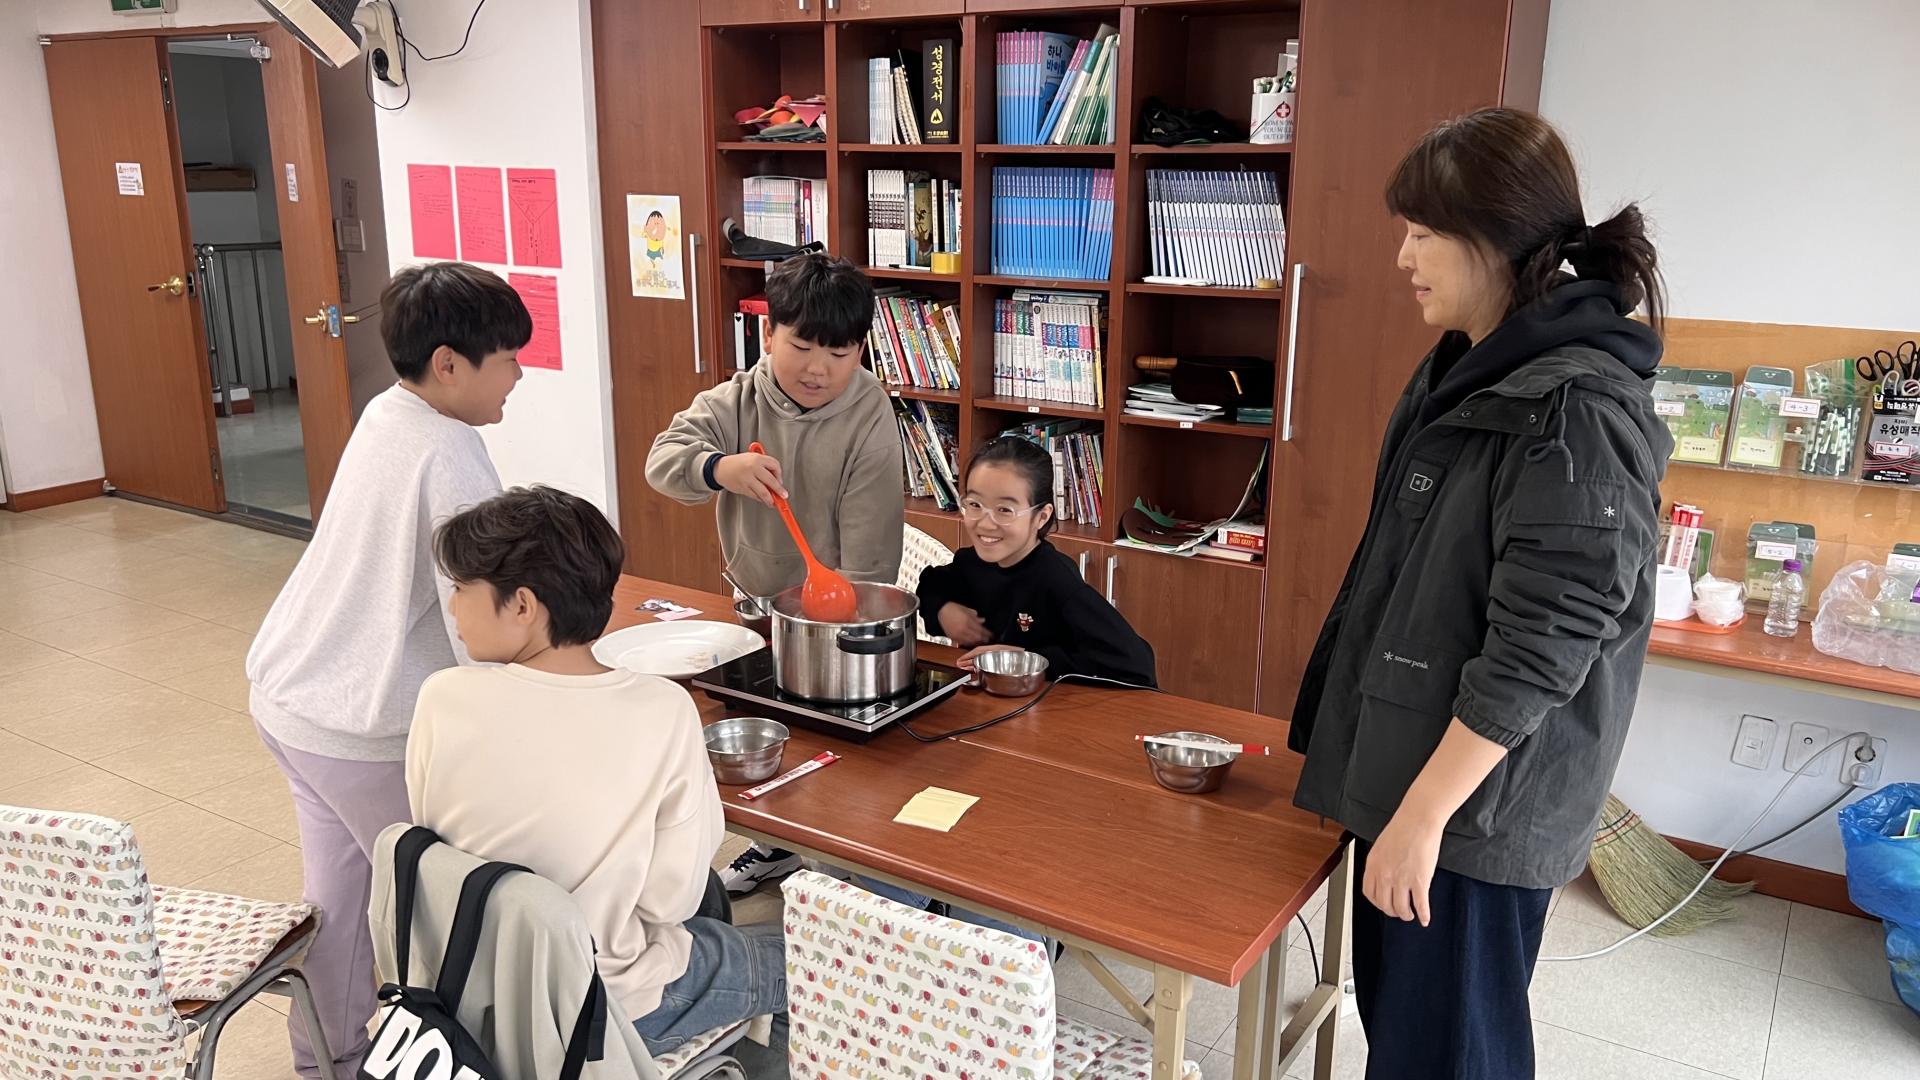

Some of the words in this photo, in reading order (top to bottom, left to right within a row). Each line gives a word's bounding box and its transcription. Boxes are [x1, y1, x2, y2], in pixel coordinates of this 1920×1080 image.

[1047, 44, 1062, 58] 하나
[931, 45, 943, 105] 성경전서
[1790, 404, 1809, 412] 4-3
[363, 1005, 487, 1080] DO
